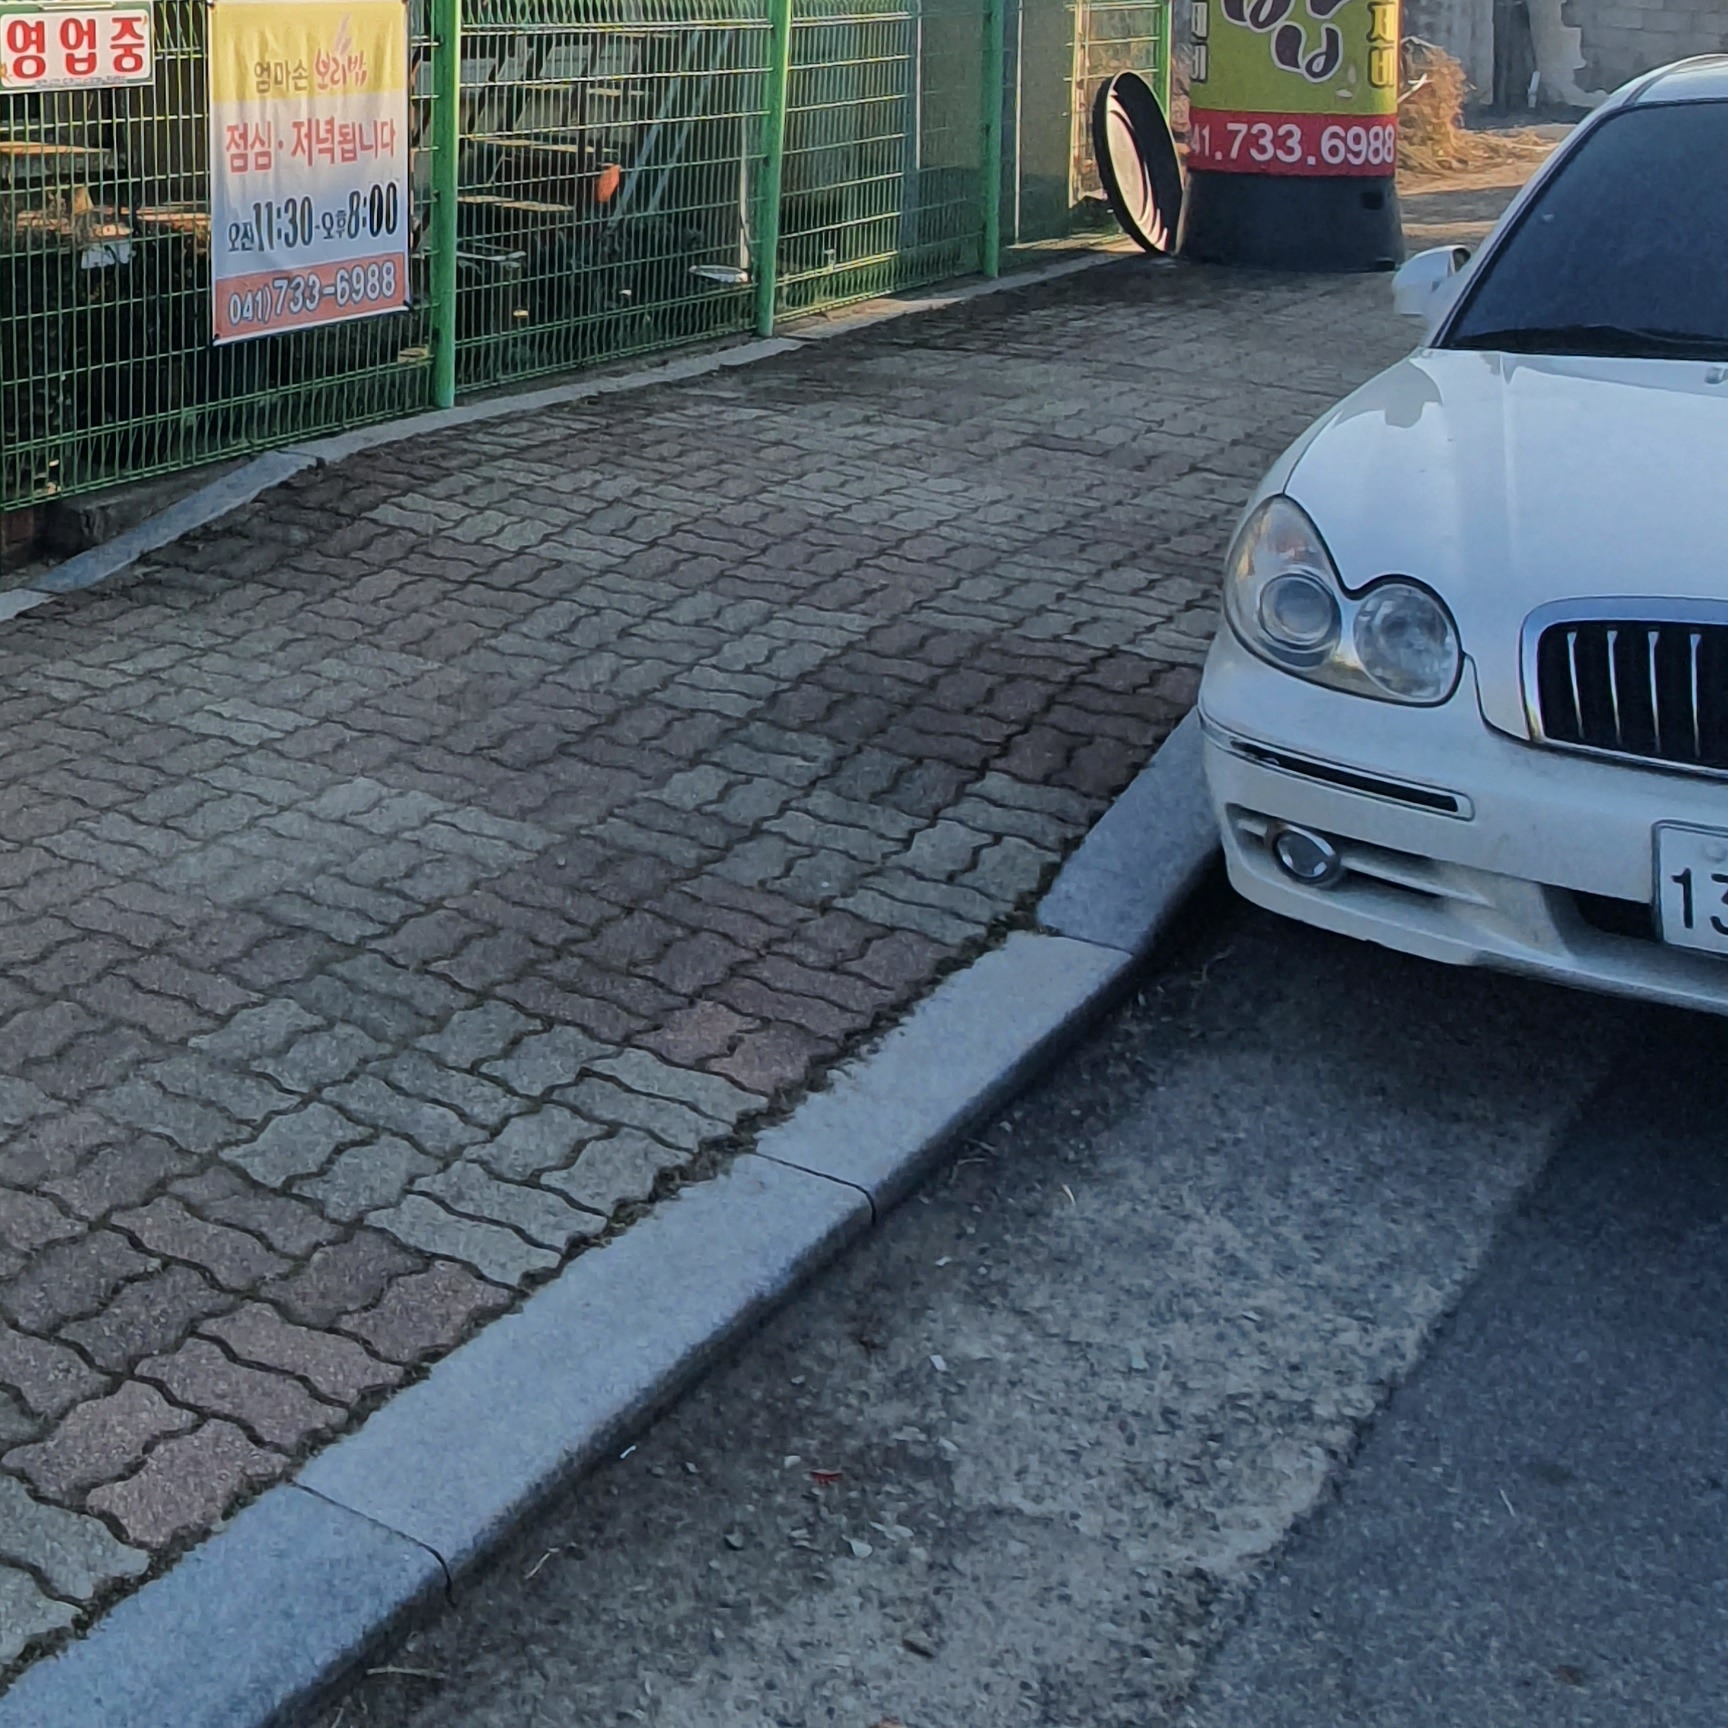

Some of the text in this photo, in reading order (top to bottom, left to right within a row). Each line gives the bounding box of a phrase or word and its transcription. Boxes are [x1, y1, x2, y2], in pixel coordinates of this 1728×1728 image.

[6, 17, 146, 80] 영업중
[254, 47, 368, 94] 엄마손 보리밥
[1191, 122, 1395, 166] 41.733.6988
[229, 259, 396, 326] 041)733-6988
